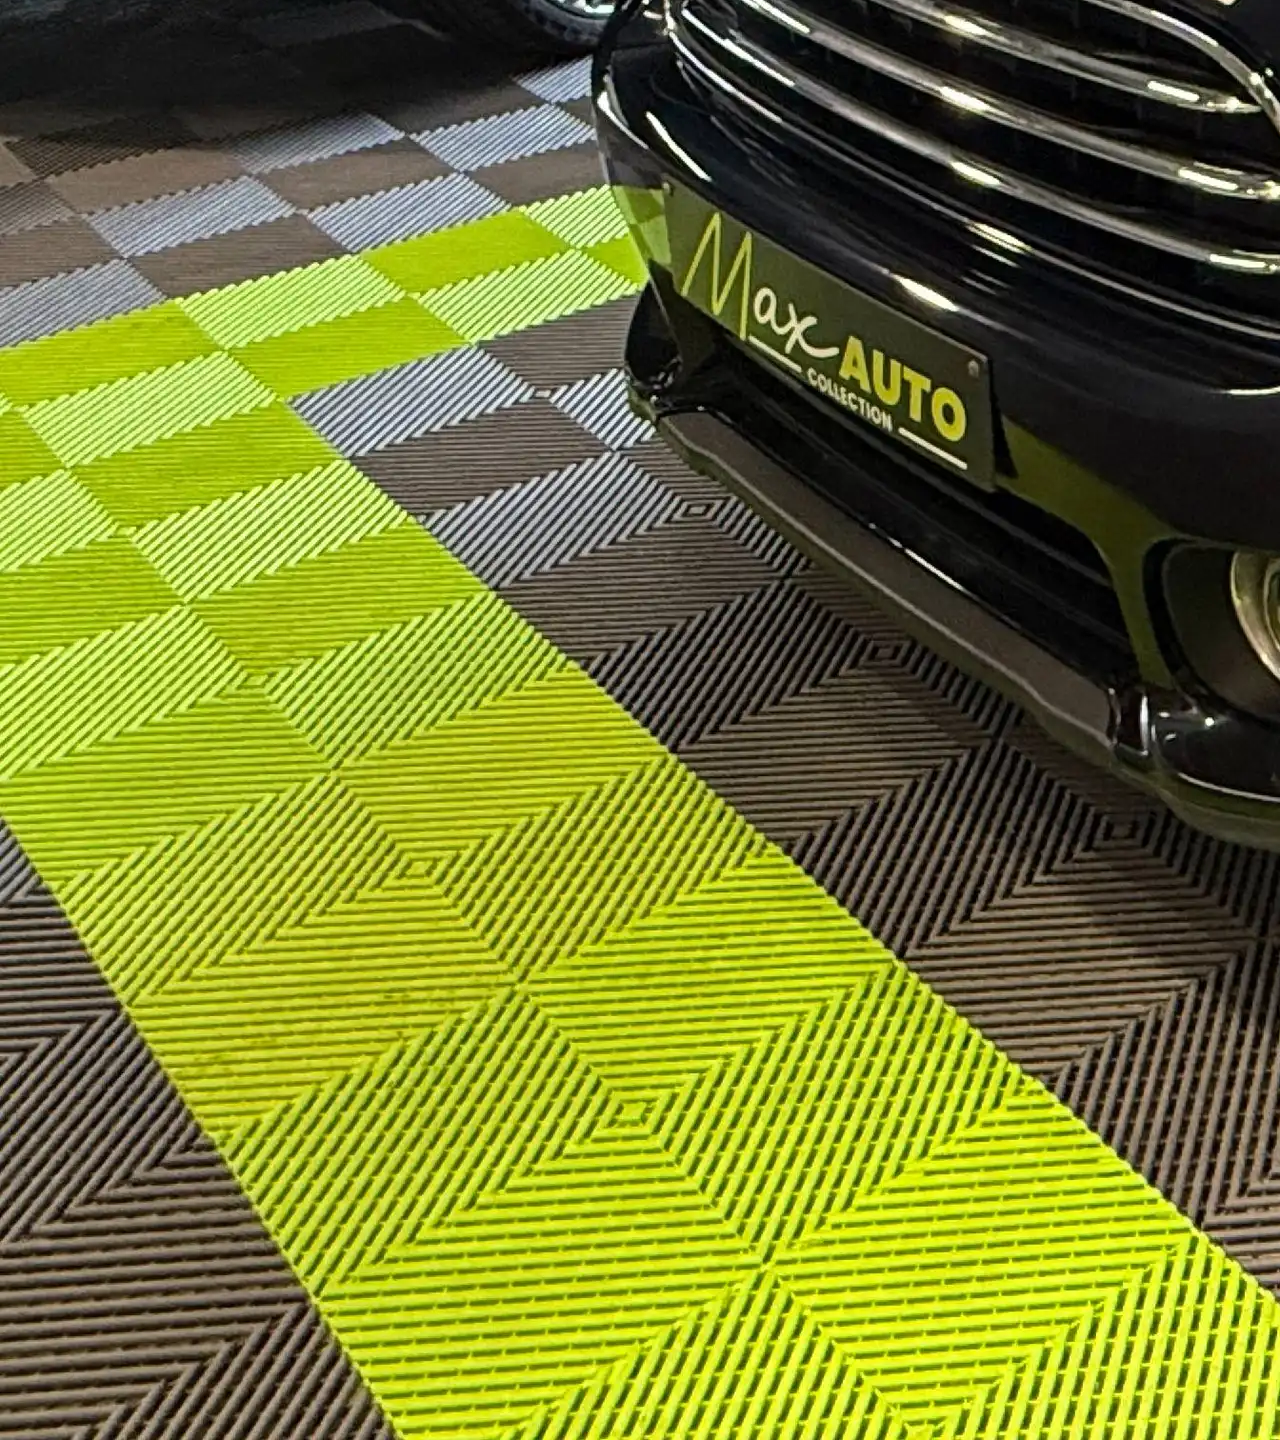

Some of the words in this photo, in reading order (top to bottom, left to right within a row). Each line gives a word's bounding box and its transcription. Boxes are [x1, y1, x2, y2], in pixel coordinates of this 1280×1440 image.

[682, 212, 840, 357] Max
[838, 335, 968, 442] AUTO
[806, 366, 893, 433] COLLECTION
